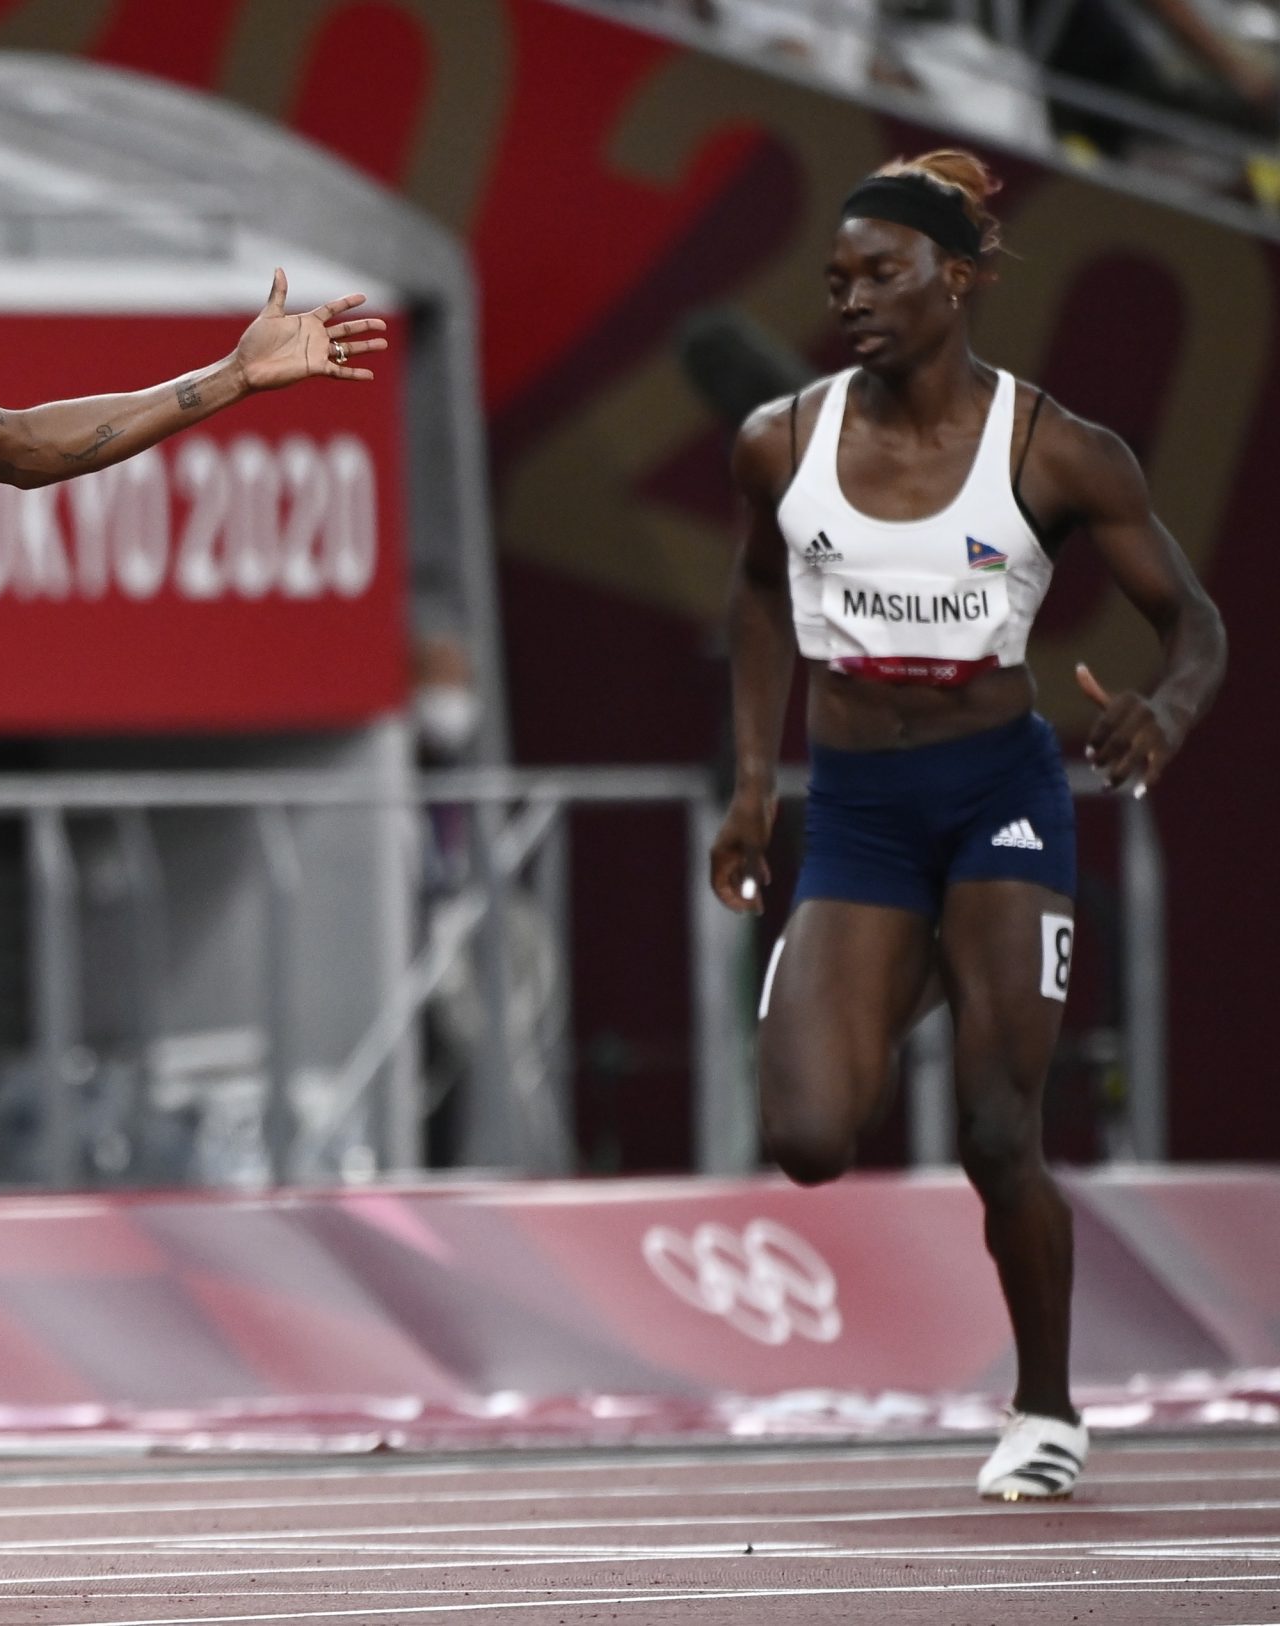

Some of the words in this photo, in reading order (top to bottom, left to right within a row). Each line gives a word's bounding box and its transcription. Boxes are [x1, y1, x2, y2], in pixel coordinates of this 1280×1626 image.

[176, 434, 378, 600] 2020
[843, 590, 989, 624] MASILINGI
[991, 835, 1043, 850] adidas
[1055, 927, 1071, 991] 8
